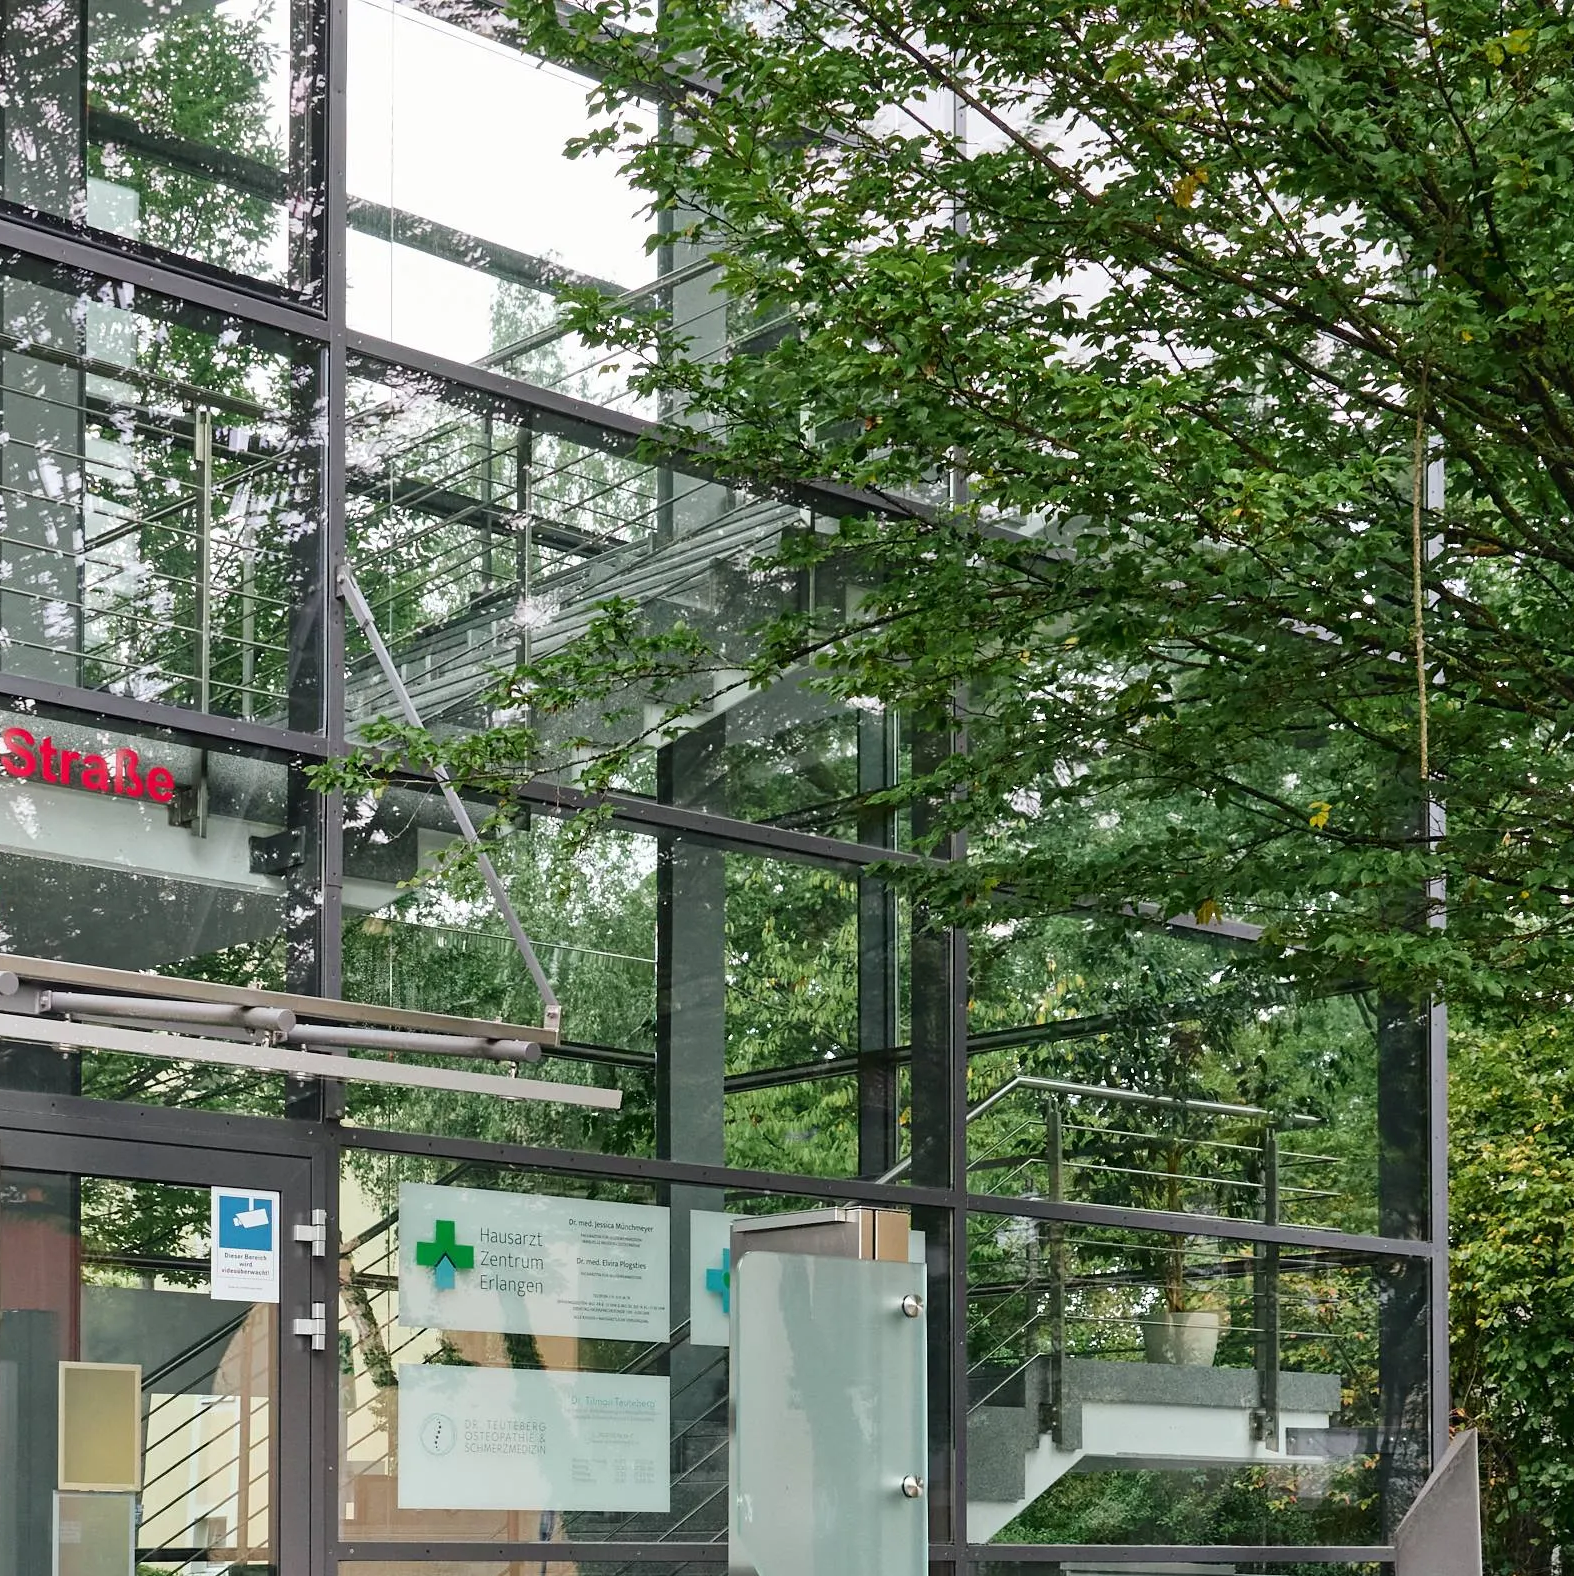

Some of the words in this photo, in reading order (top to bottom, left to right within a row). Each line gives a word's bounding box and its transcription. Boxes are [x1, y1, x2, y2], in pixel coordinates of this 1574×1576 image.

[594, 1221, 615, 1230] Jessica
[480, 1227, 544, 1247] Hausarzt
[480, 1250, 544, 1270] Zentrum
[480, 1274, 544, 1297] Erlangen
[487, 1419, 547, 1432] TEUTEBERG
[465, 1431, 535, 1443] OSTEOPATHIE
[465, 1442, 546, 1455] SCHMERZMEDIZIN
